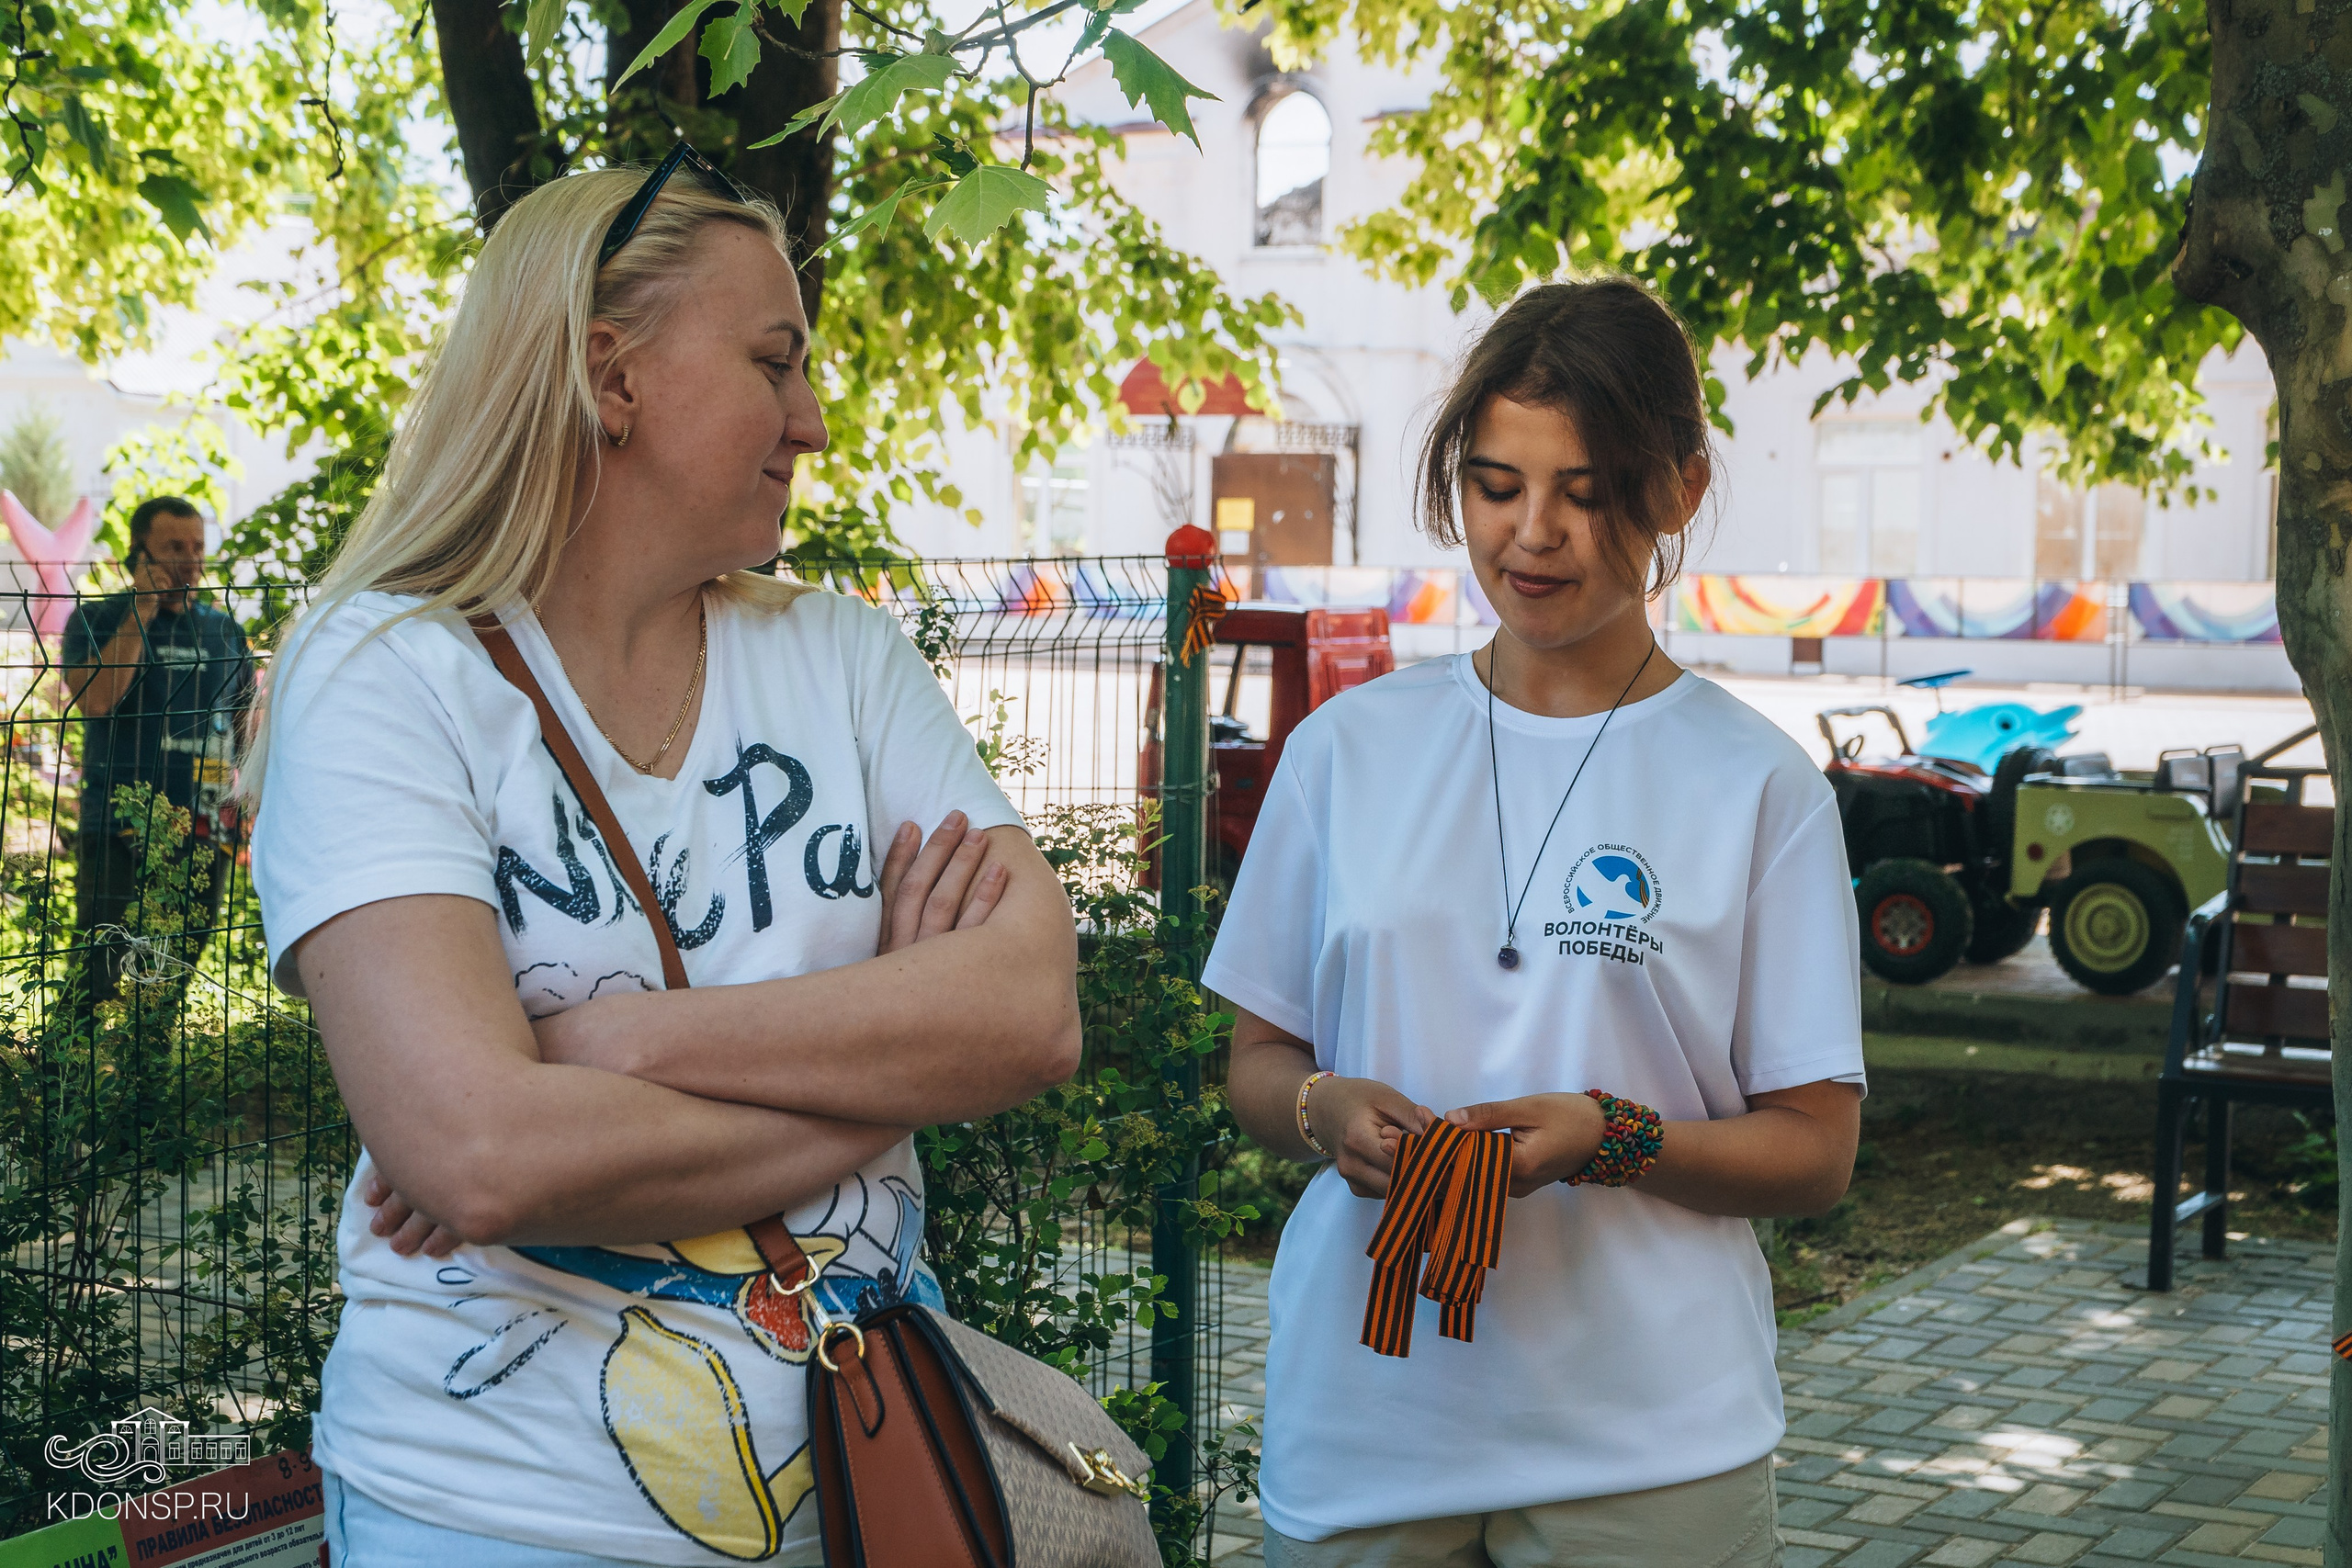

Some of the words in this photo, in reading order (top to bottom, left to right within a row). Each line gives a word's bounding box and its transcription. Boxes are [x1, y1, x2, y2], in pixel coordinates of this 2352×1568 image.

[1563, 846, 1597, 914] ВСЕРОССИЙСКОЕ
[1597, 843, 1660, 886] ОБЩЕСТВЕННОЕ
[1640, 886, 1663, 924] ДВИЖЕНИЕ
[1544, 920, 1664, 954] ВОЛОНТЁРЫ
[1558, 940, 1645, 965] ПОБЕДЫ
[136, 1519, 210, 1562] ПРАВИЛА
[210, 1482, 323, 1536] БЕЗОПАСНОСТ
[232, 1544, 244, 1555] для
[244, 1538, 263, 1551] детей
[264, 1535, 271, 1543] от
[277, 1531, 285, 1541] до
[285, 1526, 294, 1536] 12
[294, 1524, 305, 1533] лет
[288, 1531, 324, 1549] обязательн
